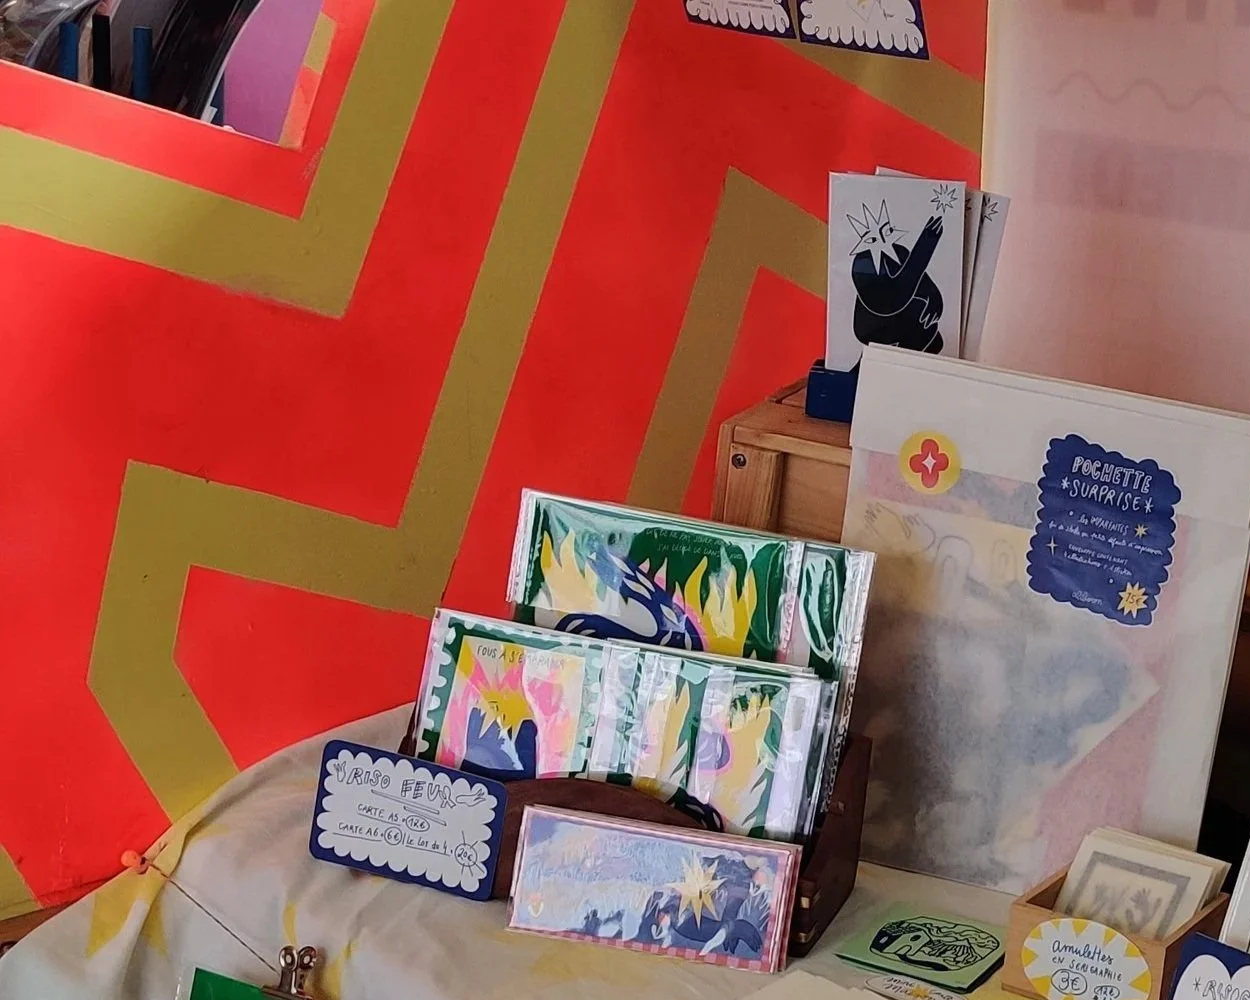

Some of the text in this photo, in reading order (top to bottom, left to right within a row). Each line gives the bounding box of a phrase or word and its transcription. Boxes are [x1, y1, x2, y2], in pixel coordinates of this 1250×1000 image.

[1072, 456, 1153, 493] POCHETTE
[1069, 479, 1142, 511] SURPRISE
[346, 767, 457, 808] RISO FEUX
[357, 803, 384, 819] CARTE
[387, 812, 399, 822] A5
[338, 822, 363, 836] CARTE
[366, 825, 379, 838] A6
[1052, 940, 1114, 965] amulettes
[1058, 970, 1081, 991] 3€
